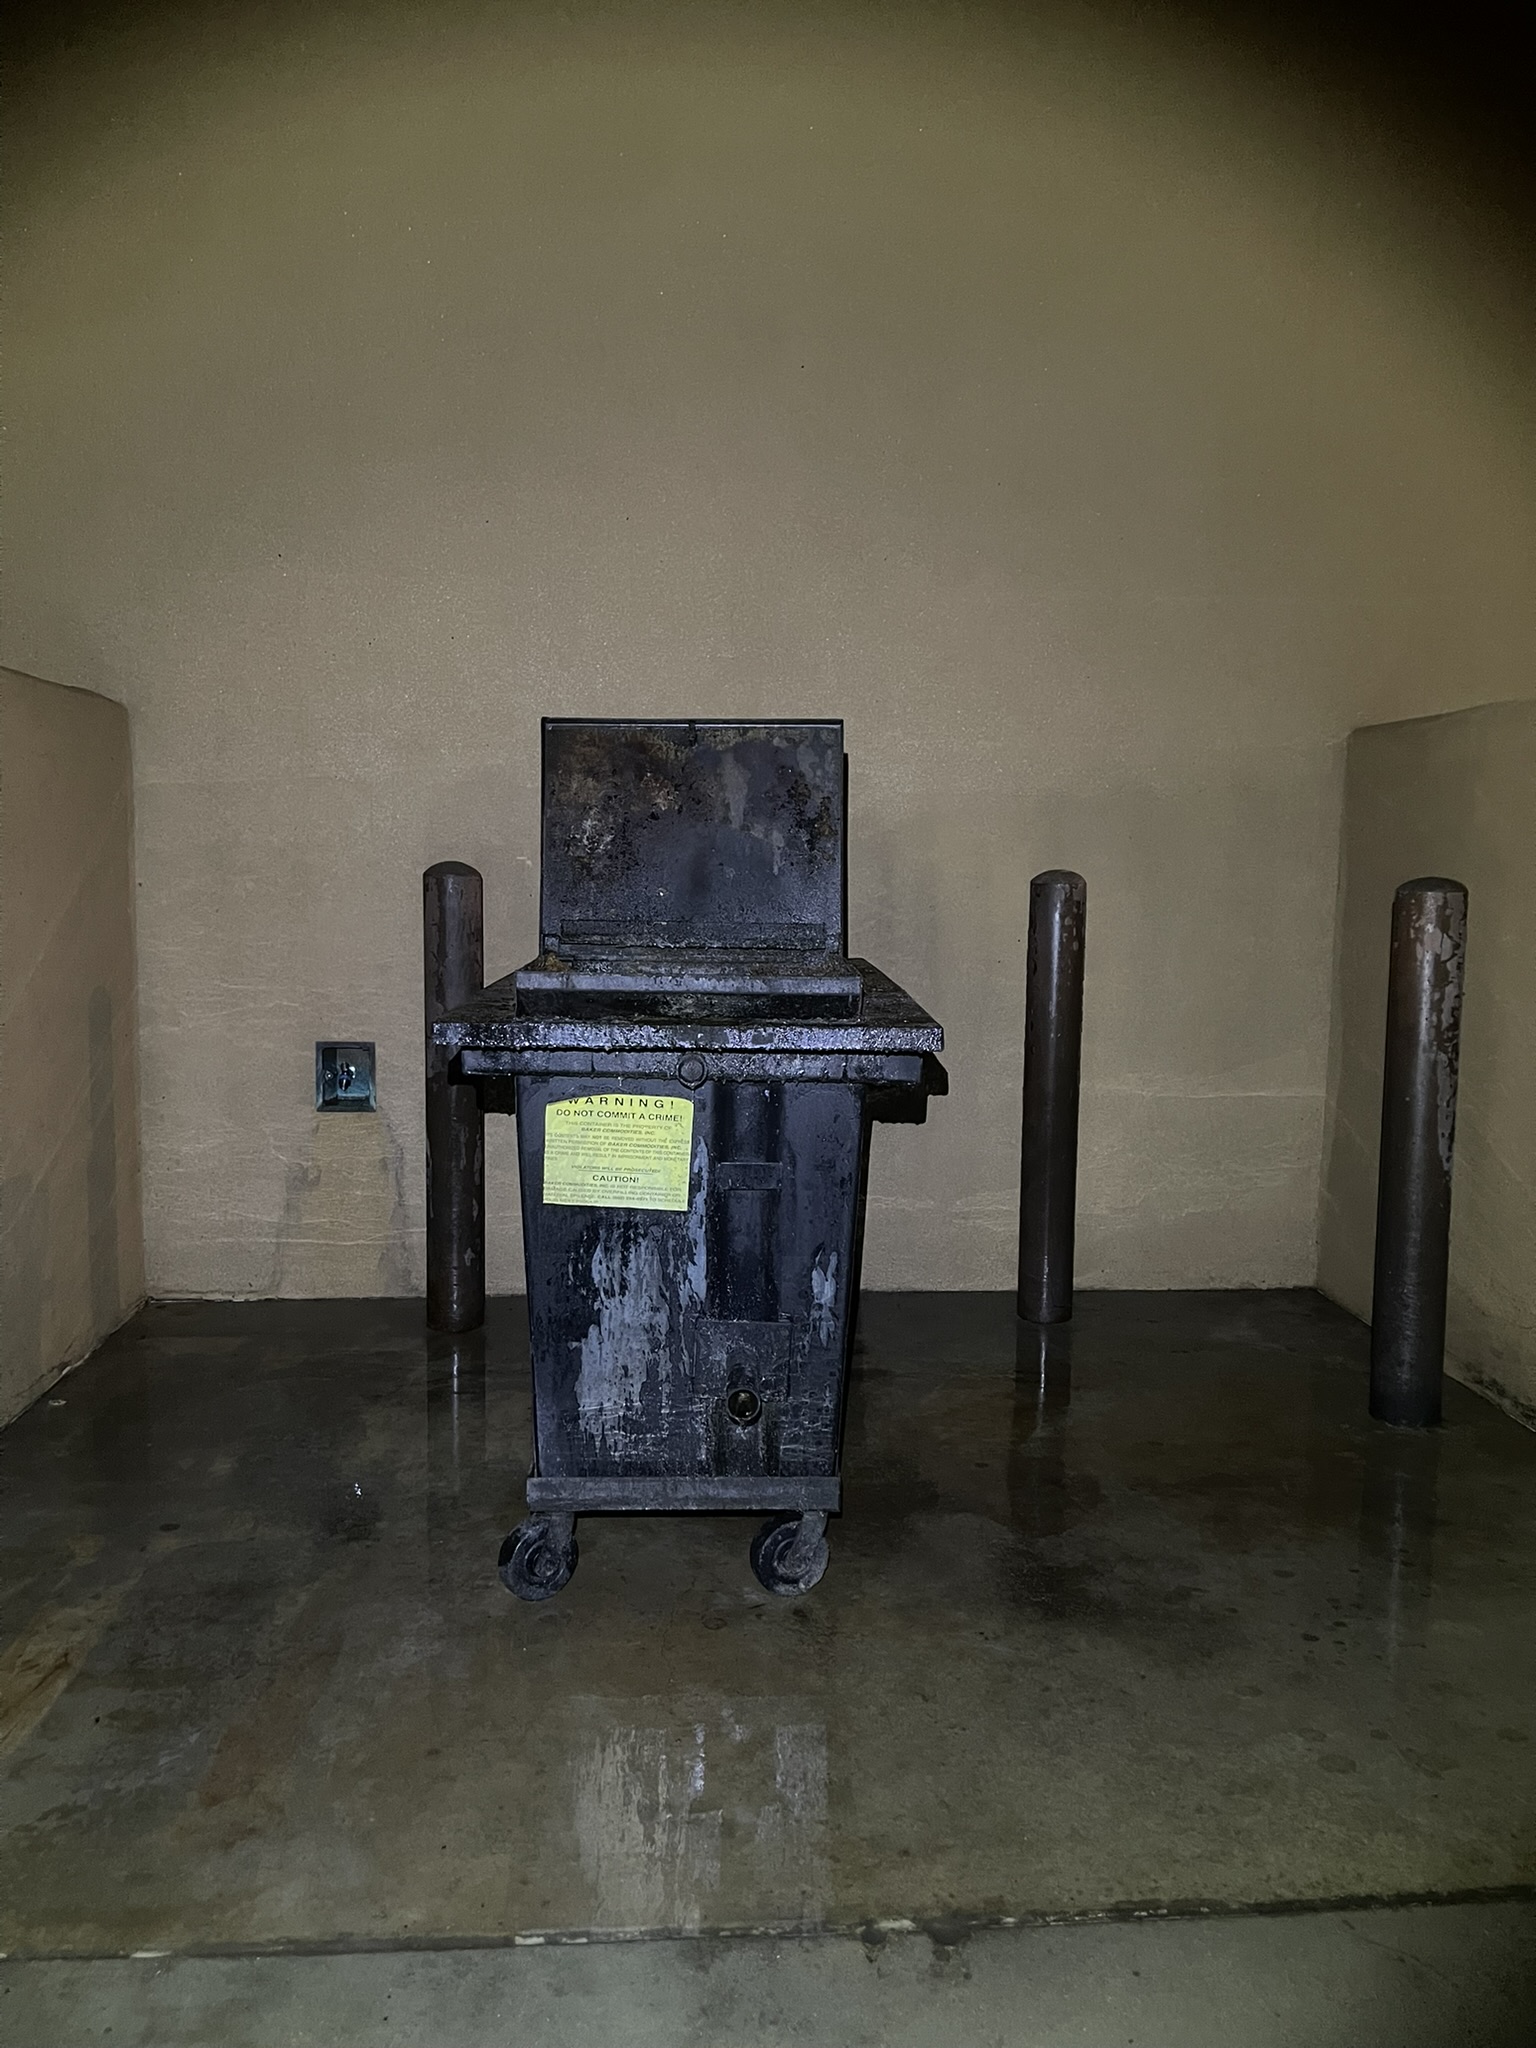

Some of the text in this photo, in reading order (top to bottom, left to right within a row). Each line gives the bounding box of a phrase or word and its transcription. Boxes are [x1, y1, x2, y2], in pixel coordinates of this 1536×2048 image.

[569, 1096, 674, 1109] WARNING!
[556, 1108, 571, 1117] DO
[597, 1110, 636, 1119] COMMIT
[648, 1113, 683, 1122] CRIME!
[592, 1174, 640, 1183] CAUTION!
